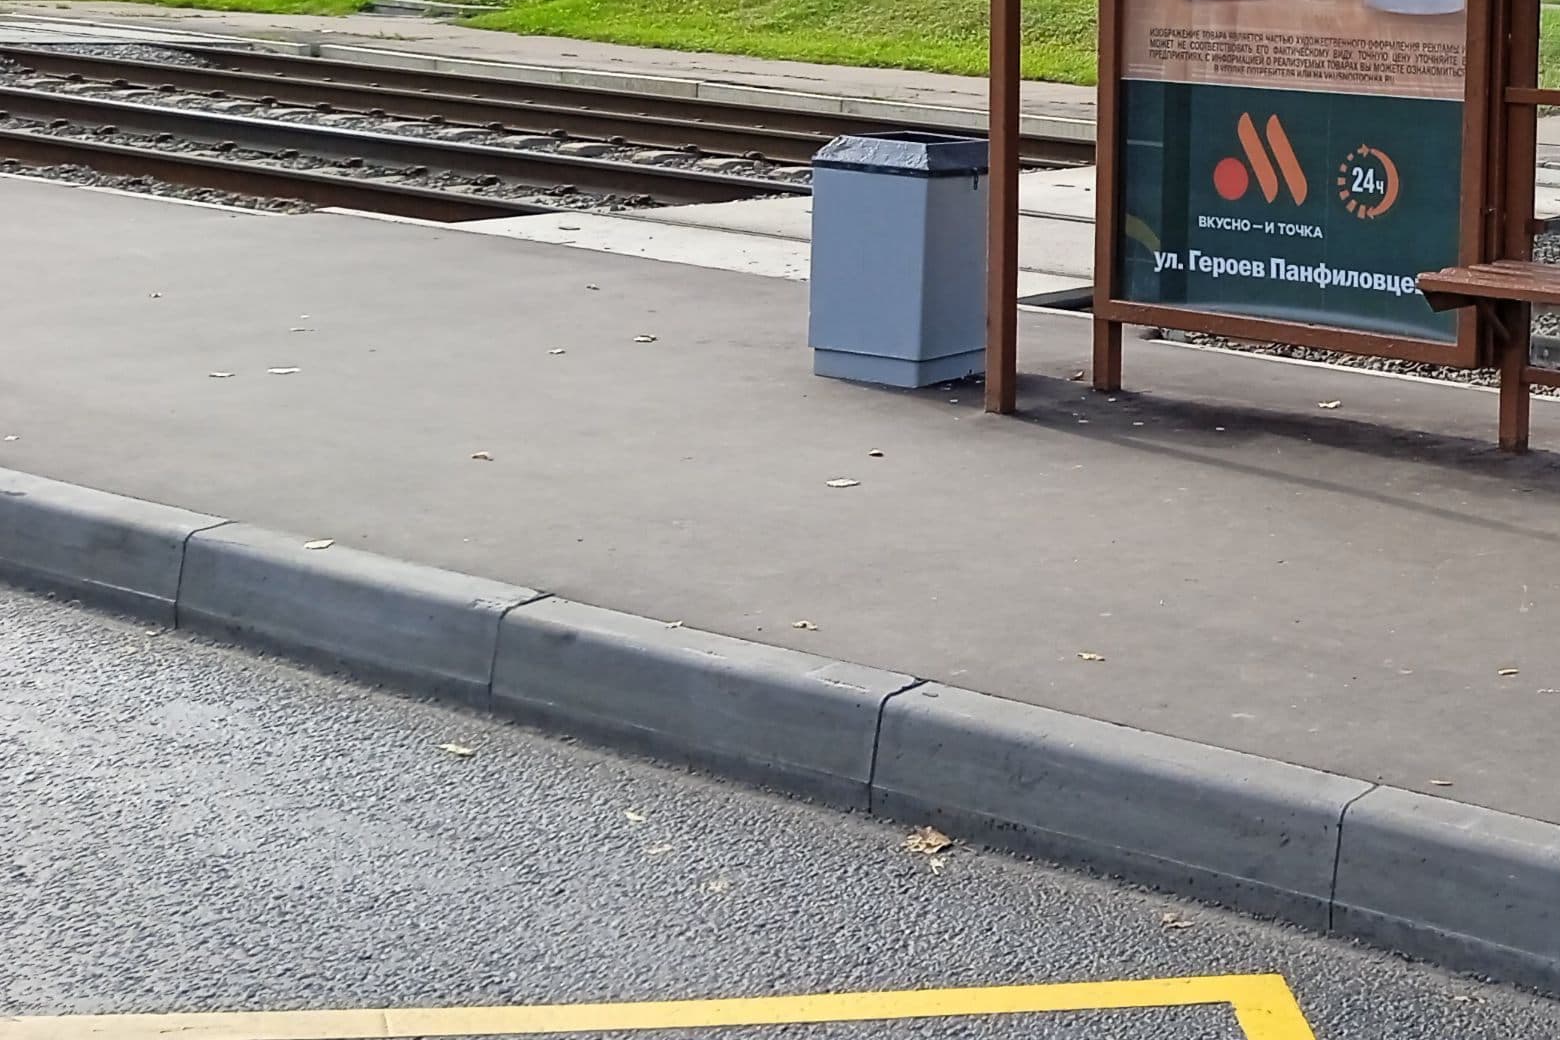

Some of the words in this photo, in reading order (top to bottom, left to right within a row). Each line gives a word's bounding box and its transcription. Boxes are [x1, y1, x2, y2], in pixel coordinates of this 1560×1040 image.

[1198, 215, 1251, 232] ВКУСНО
[1264, 221, 1275, 234] И
[1277, 222, 1324, 239] ТОЧКА
[1153, 250, 1184, 273] ул.
[1188, 249, 1266, 278] Героев
